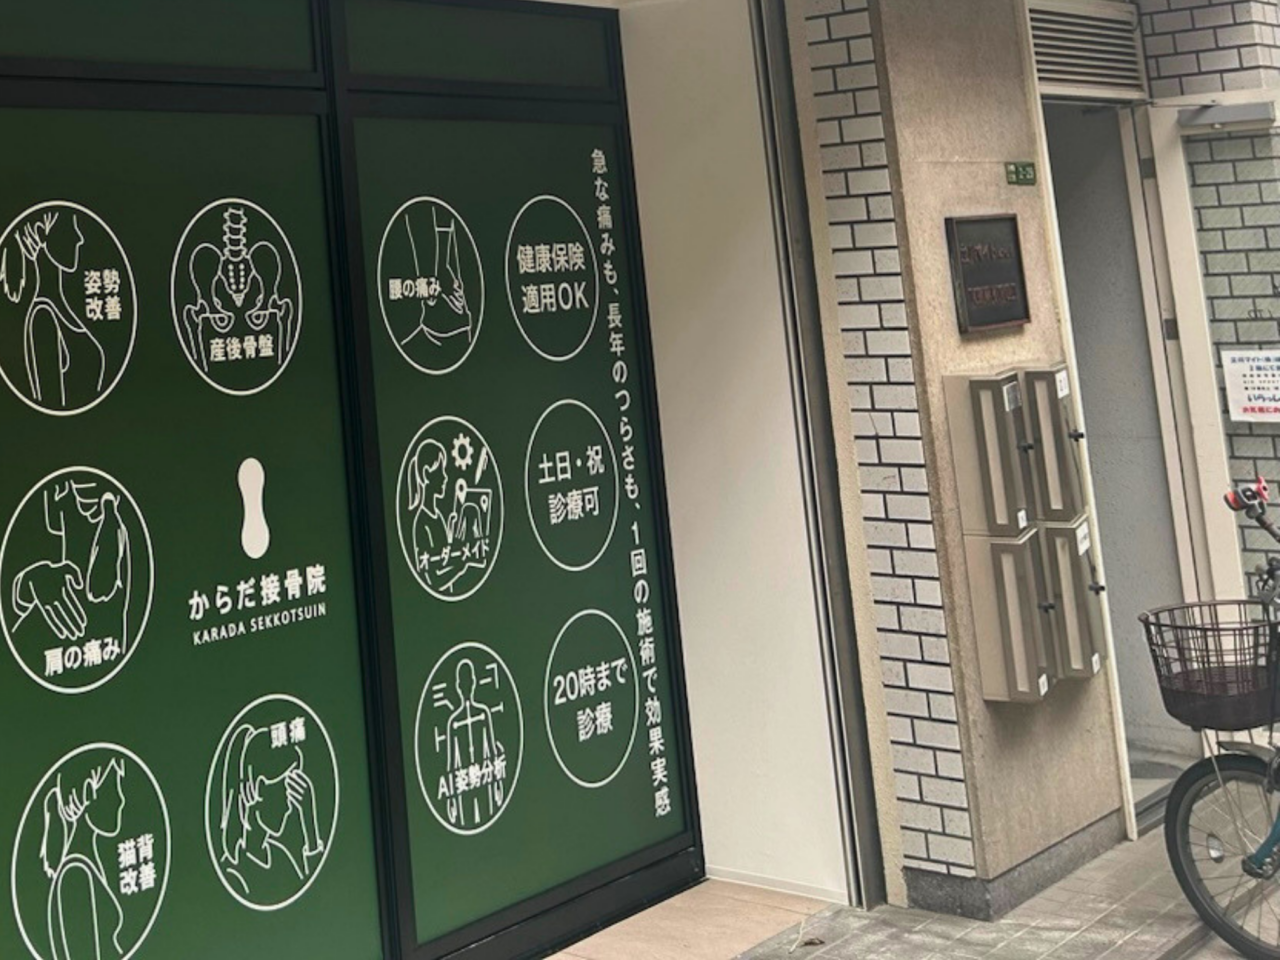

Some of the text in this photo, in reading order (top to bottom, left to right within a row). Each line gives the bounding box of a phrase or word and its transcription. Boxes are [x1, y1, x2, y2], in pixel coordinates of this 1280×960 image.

[516, 242, 586, 274] 健康保険
[84, 269, 120, 296] 姿勢
[388, 276, 442, 301] 腰の痛み
[521, 282, 588, 315] 適用OK
[84, 296, 122, 322] 改善
[210, 333, 275, 362] 産後骨盤
[538, 445, 605, 484] 土日・祝
[548, 486, 601, 525] 診療可
[419, 538, 490, 571] オーダーメイド
[188, 563, 327, 621] からだ接骨院
[193, 602, 327, 646] KARADA SEKKOTSUIN
[44, 637, 121, 677] 肩の痛み
[552, 656, 628, 705] 20時まで
[270, 716, 306, 749] 頭痛
[576, 702, 613, 742] 診療
[117, 833, 154, 869] 猫背
[119, 861, 157, 896] 改善
